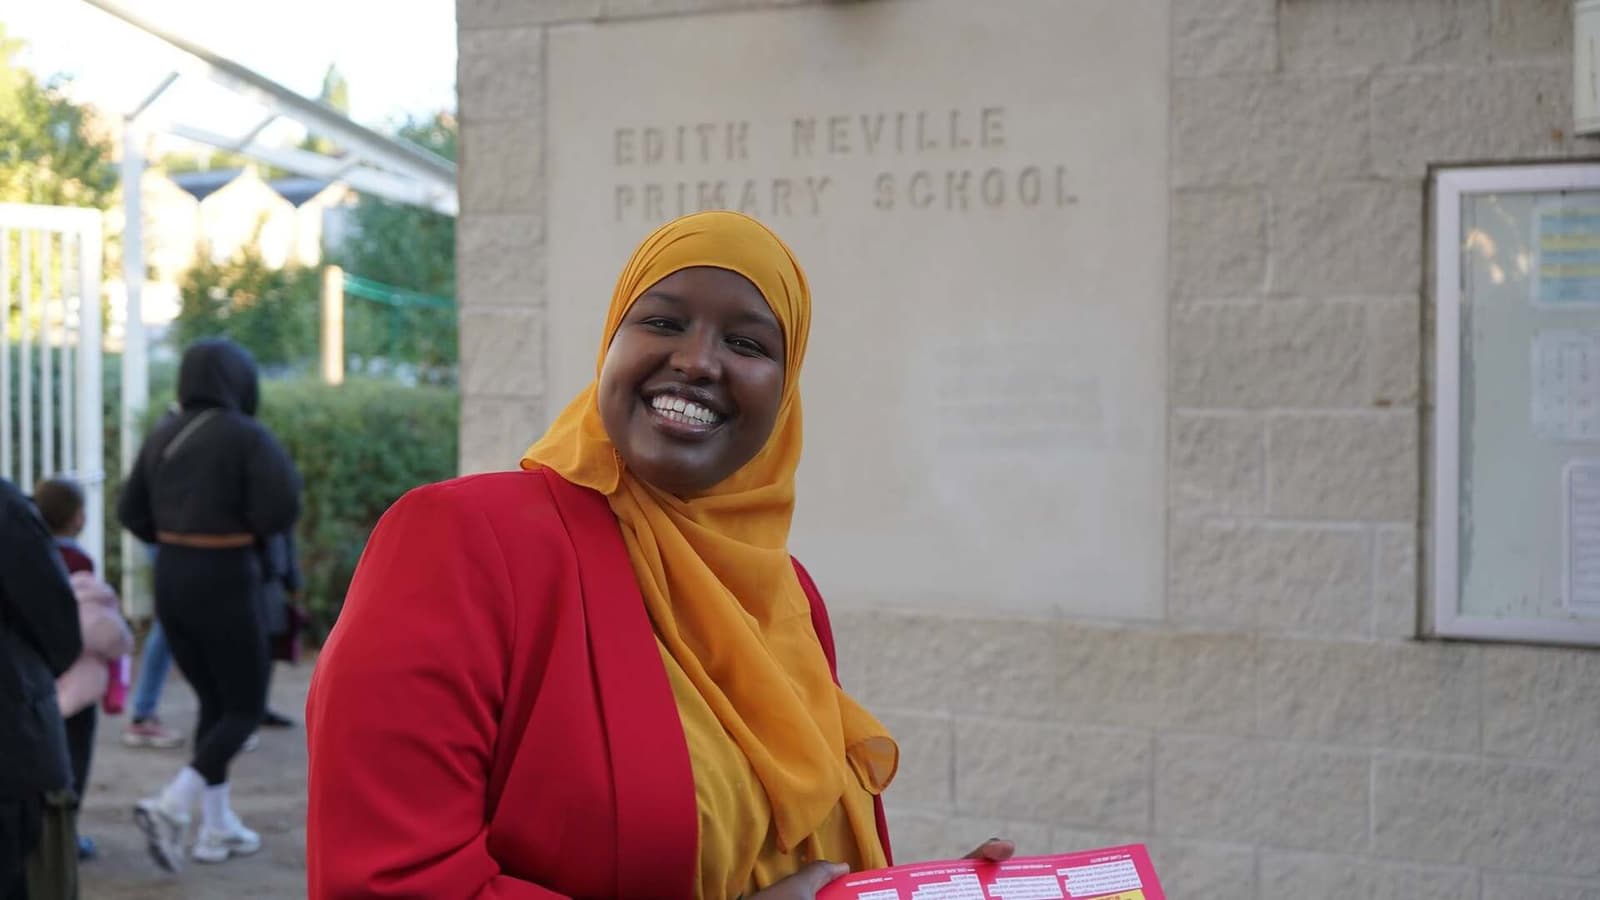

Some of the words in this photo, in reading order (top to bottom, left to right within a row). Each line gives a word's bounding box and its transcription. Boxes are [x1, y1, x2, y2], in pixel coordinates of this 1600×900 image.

[614, 120, 751, 166] EDITH
[790, 107, 1008, 157] NEVILLE
[613, 176, 832, 222] PRIMARY
[873, 166, 1080, 212] SCHOOL
